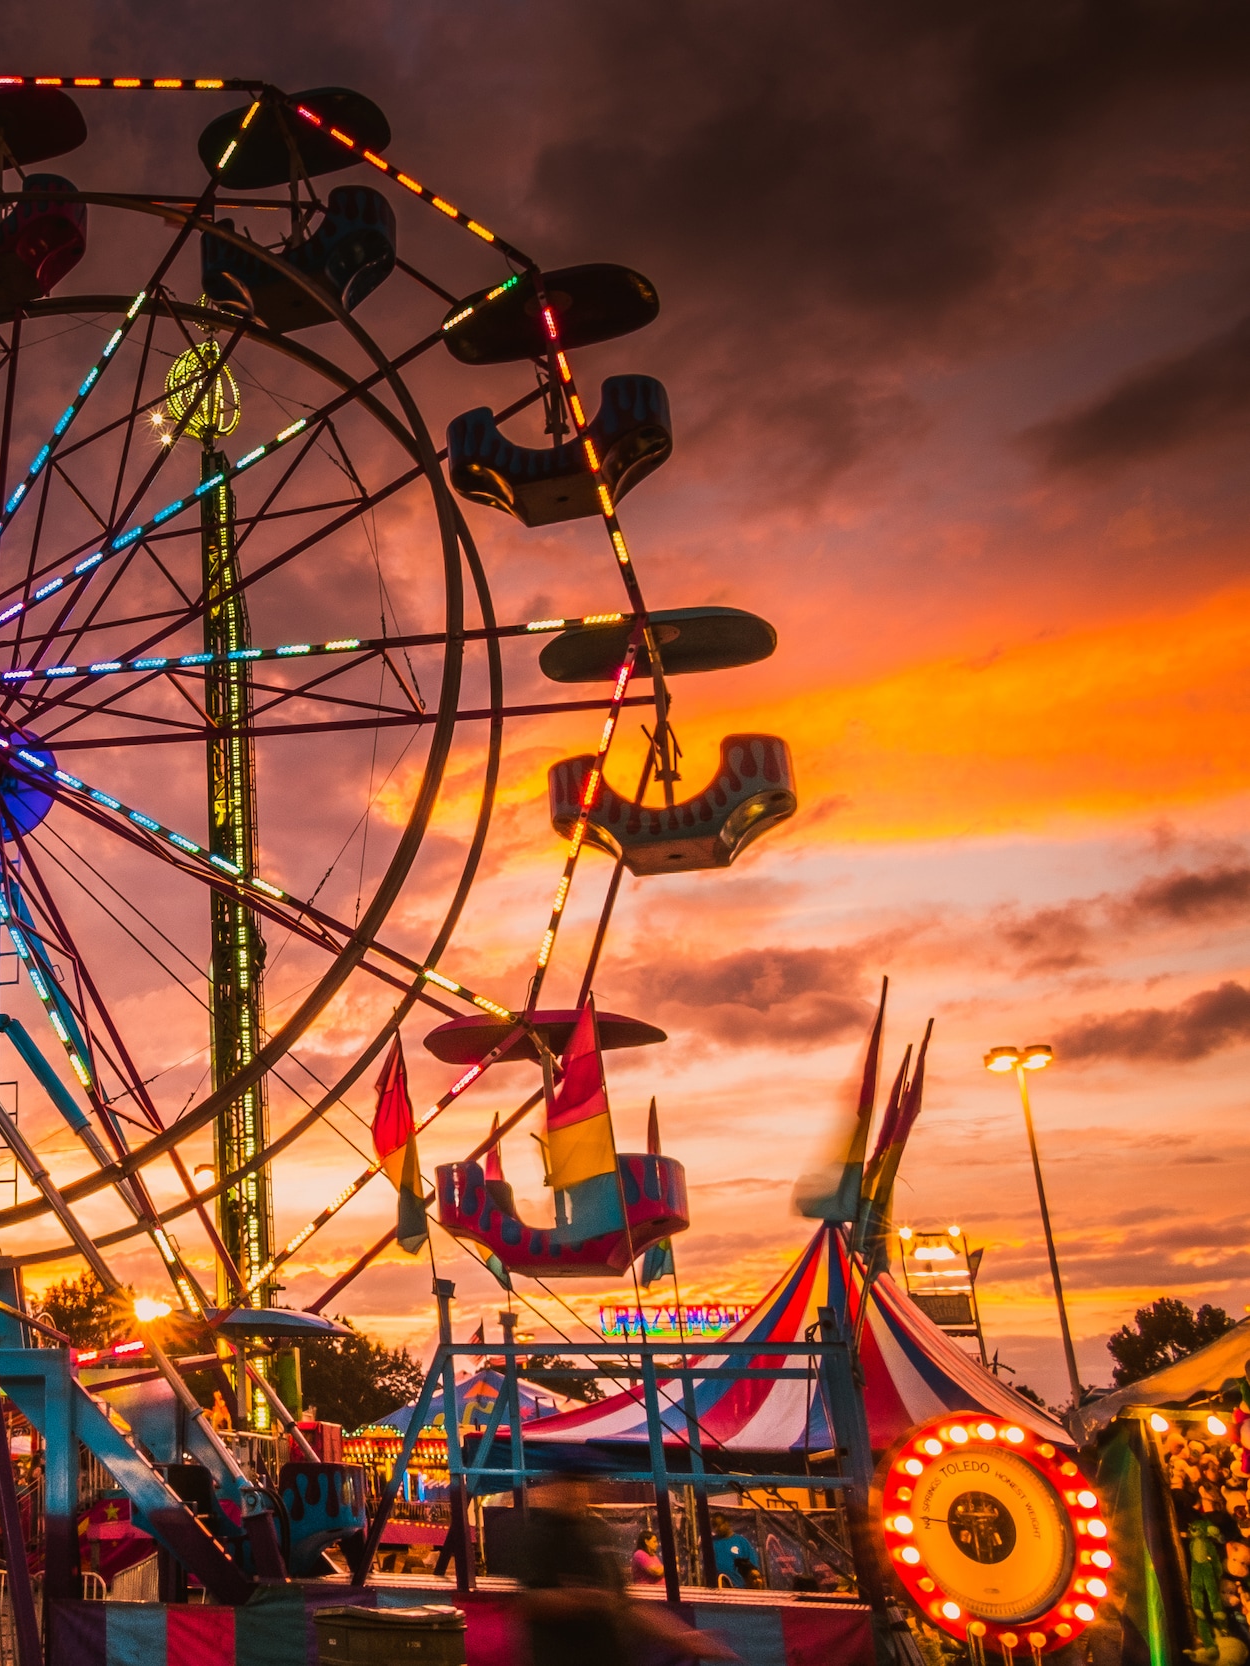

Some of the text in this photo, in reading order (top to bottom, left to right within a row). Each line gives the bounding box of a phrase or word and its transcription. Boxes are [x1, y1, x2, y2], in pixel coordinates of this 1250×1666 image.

[599, 1305, 678, 1337] CRAZY
[922, 1460, 1041, 1539] NO SPRINGS TOLEDO HONEST WEIGHT
